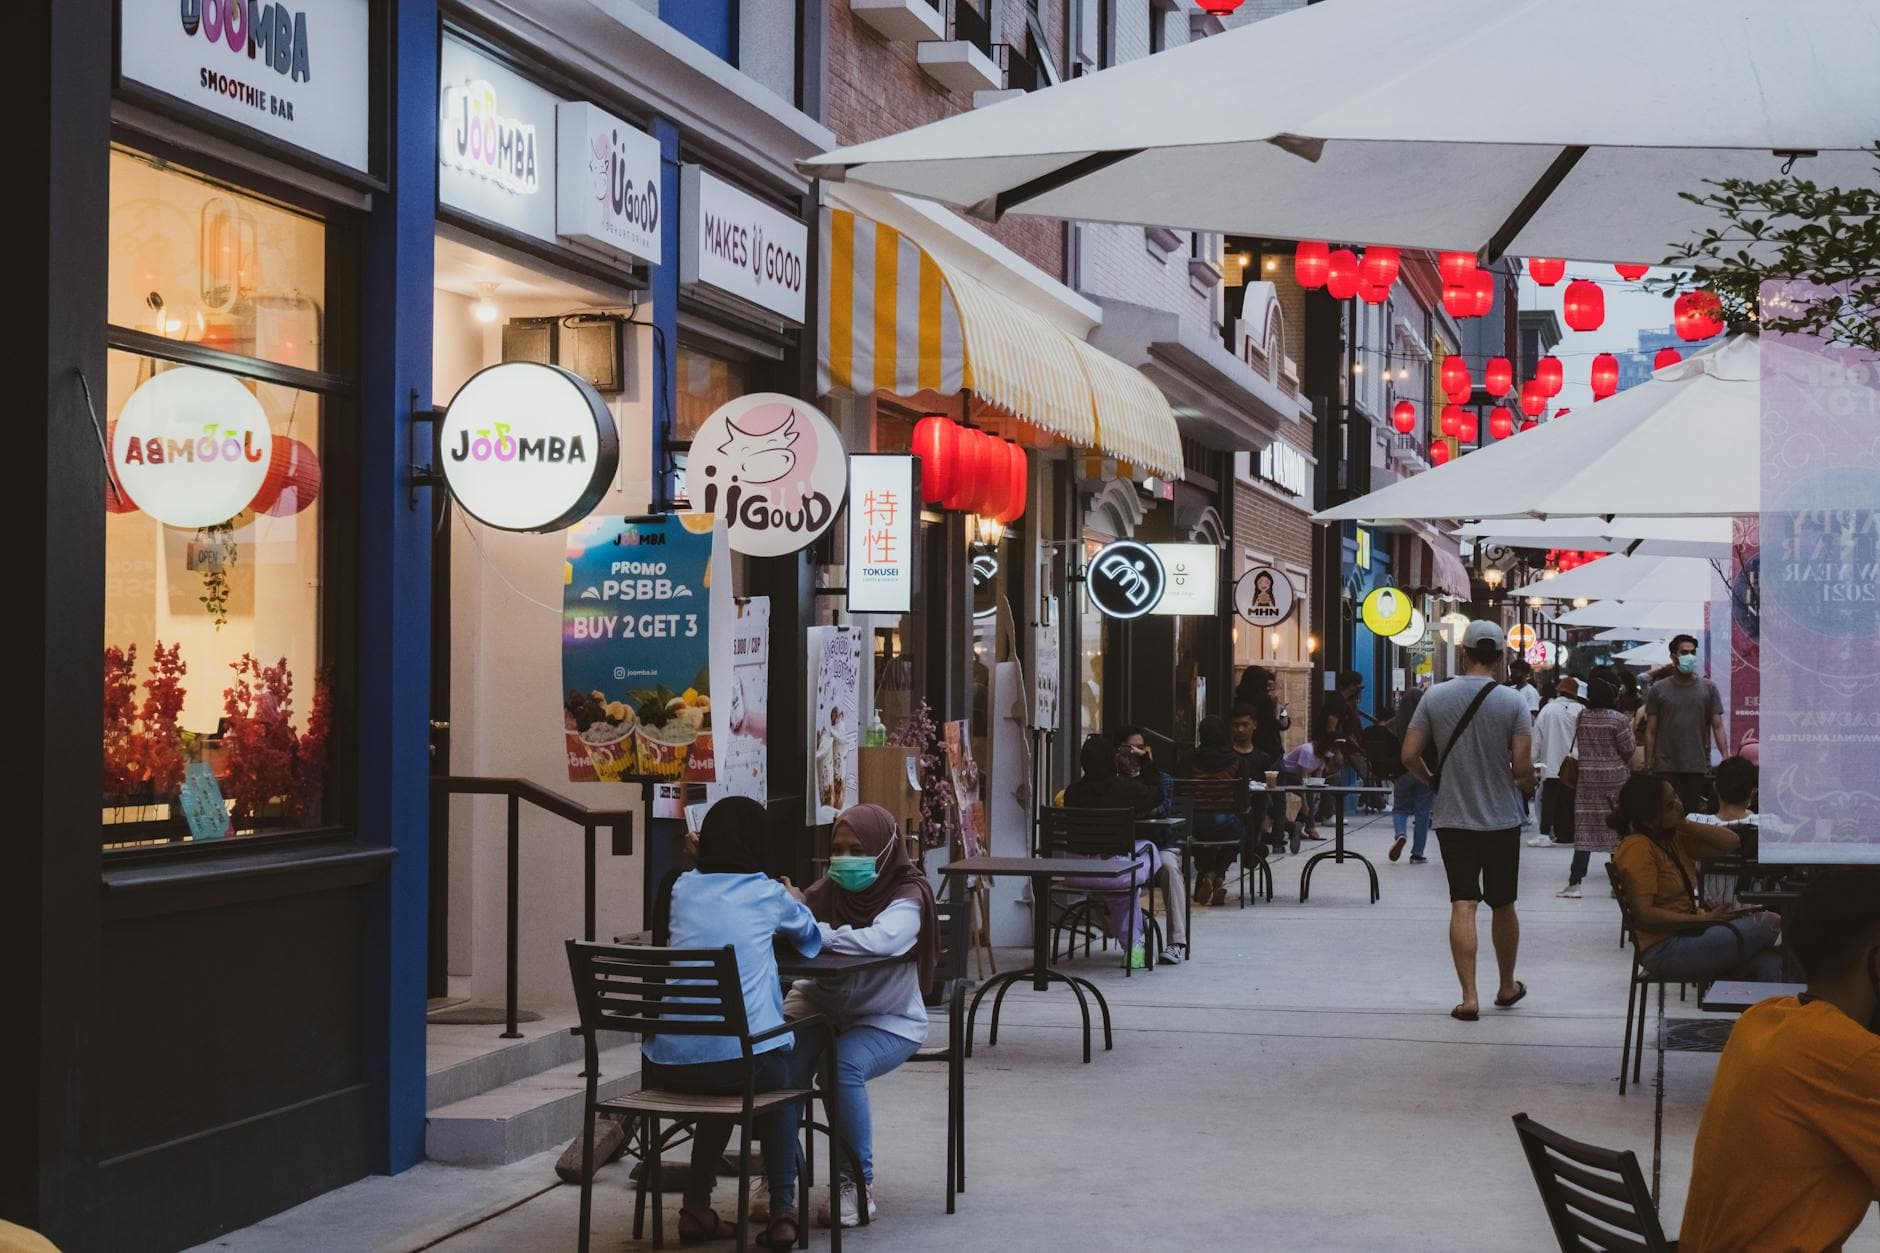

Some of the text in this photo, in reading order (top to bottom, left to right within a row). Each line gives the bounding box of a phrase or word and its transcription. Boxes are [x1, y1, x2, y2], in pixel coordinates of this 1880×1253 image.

[200, 67, 294, 121] SMOOTHIE BAR
[457, 96, 536, 184] JOOMBA
[704, 210, 748, 268] MAKES
[765, 242, 801, 293] GOOD
[451, 429, 586, 464] JOOMBA
[613, 531, 667, 547] JOOMBA
[863, 490, 898, 564] 特性
[611, 560, 667, 576] PROMO
[862, 568, 899, 577] TOKUSEI
[603, 579, 674, 601] PSBB
[1247, 608, 1280, 616] MHN
[573, 614, 698, 639] BUY 2 GET 3
